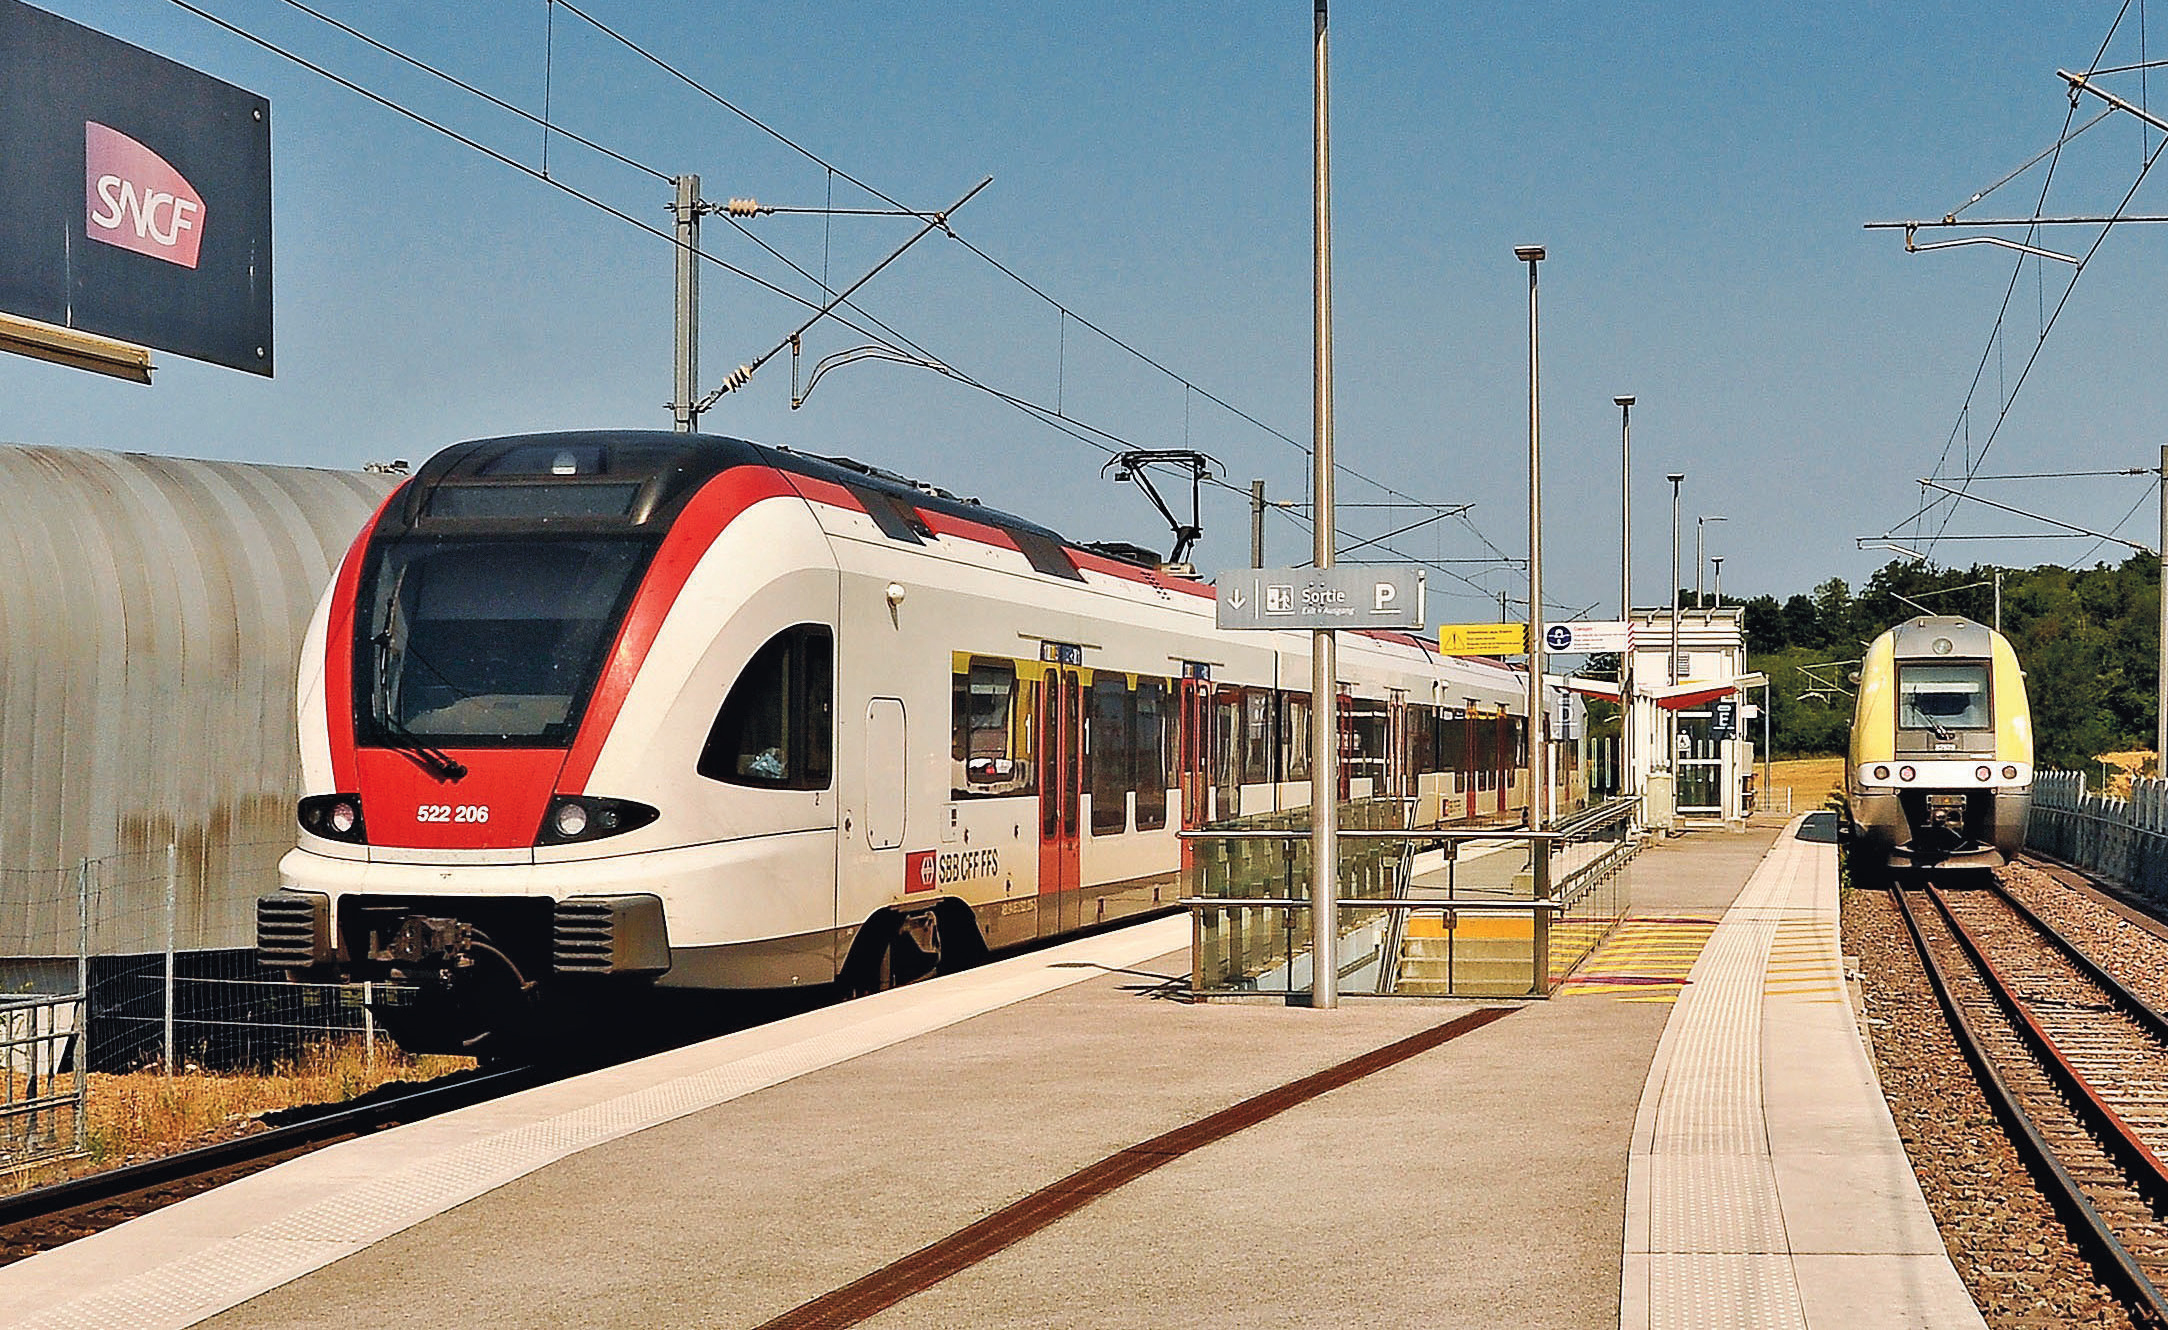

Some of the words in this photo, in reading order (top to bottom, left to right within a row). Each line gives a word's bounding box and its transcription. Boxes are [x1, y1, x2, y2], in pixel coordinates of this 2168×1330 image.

[91, 174, 198, 246] SNCF
[1301, 588, 1346, 604] Sortie
[1375, 583, 1396, 610] P
[1719, 711, 1731, 727] E
[416, 804, 452, 823] 522
[454, 804, 489, 824] 206
[939, 852, 960, 884] SBB
[961, 850, 980, 881] CFF
[980, 847, 999, 878] FFS
